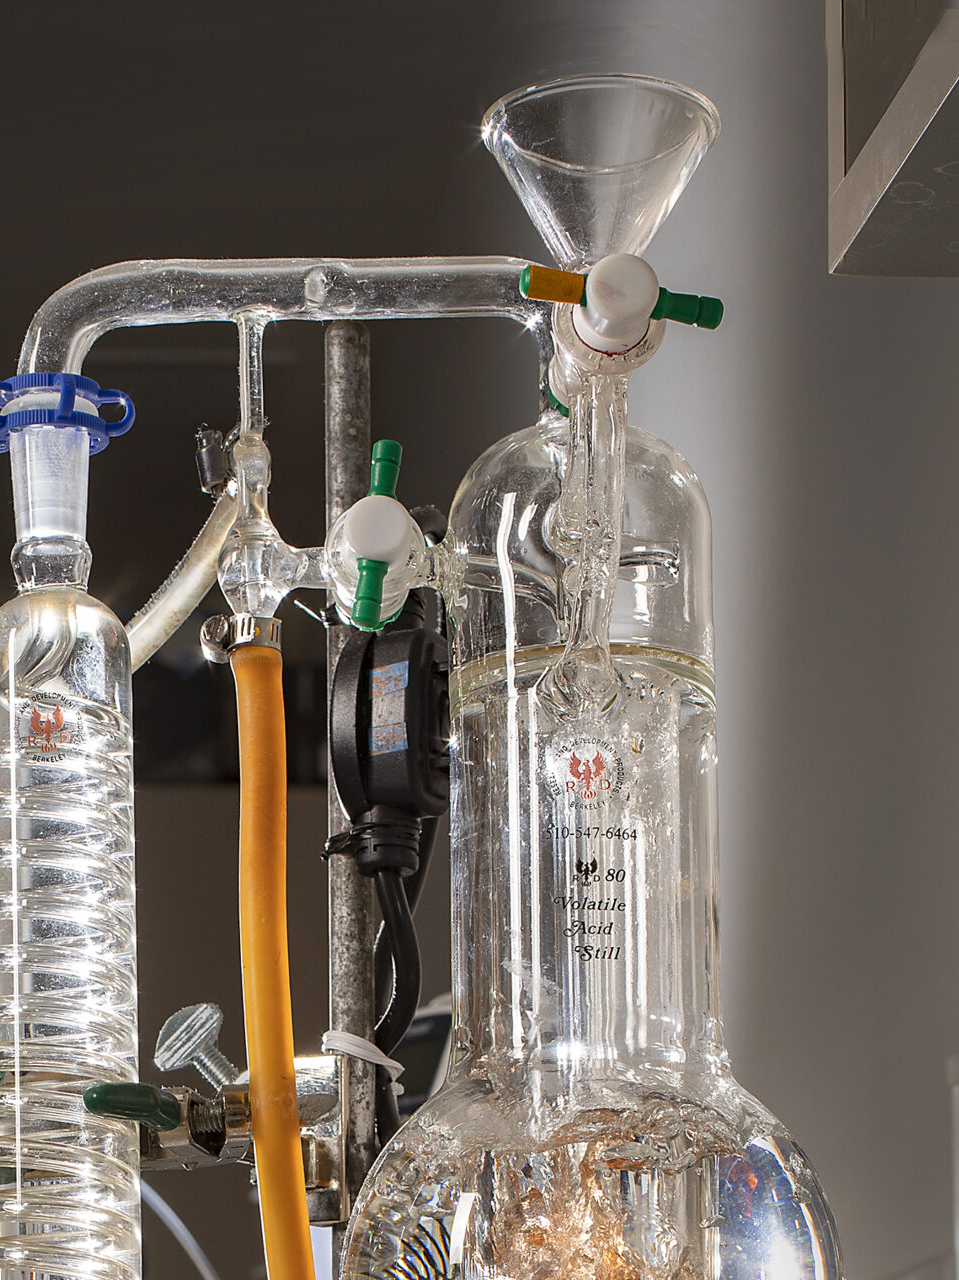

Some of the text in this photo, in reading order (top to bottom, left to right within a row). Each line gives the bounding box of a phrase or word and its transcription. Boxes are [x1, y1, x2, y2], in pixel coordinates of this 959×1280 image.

[31, 692, 77, 710] DEVELOPMENT
[32, 752, 66, 763] BERKELEY
[569, 737, 617, 758] DEVELOPMENT
[613, 757, 625, 794] PRODUCTS
[569, 800, 606, 811] BERKELEY
[546, 826, 638, 841] 510-547-6464
[605, 868, 626, 883] 80
[553, 895, 626, 912] Volatile
[563, 920, 613, 938] Acid
[574, 944, 621, 962] Still
